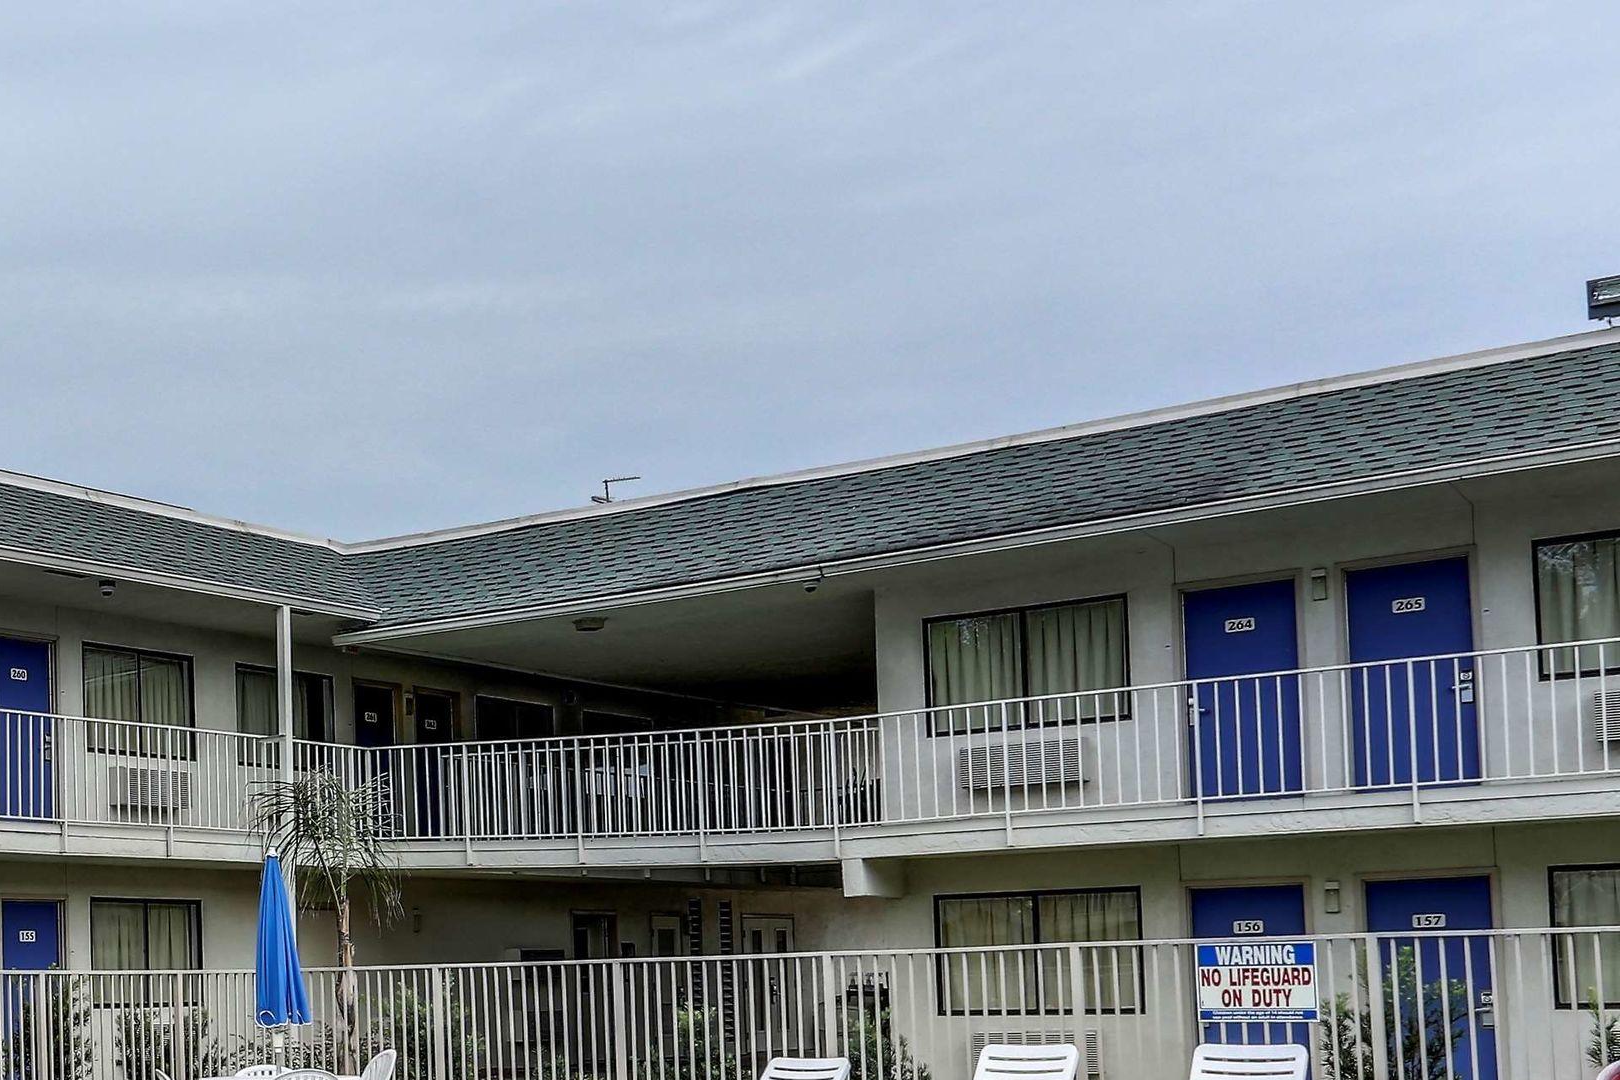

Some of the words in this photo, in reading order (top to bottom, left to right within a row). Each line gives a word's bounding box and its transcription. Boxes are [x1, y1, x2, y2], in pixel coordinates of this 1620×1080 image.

[1395, 598, 1423, 612] 265
[1227, 618, 1252, 632] 264
[12, 669, 26, 679] 260
[1236, 922, 1260, 932] 156
[1414, 915, 1442, 927] 157
[20, 931, 34, 941] 155
[1215, 945, 1296, 965] WARNING
[1201, 968, 1221, 987] NO
[1229, 967, 1312, 987] LIFEGUARD
[1221, 989, 1242, 1008] ON
[1251, 988, 1292, 1008] DUTY
